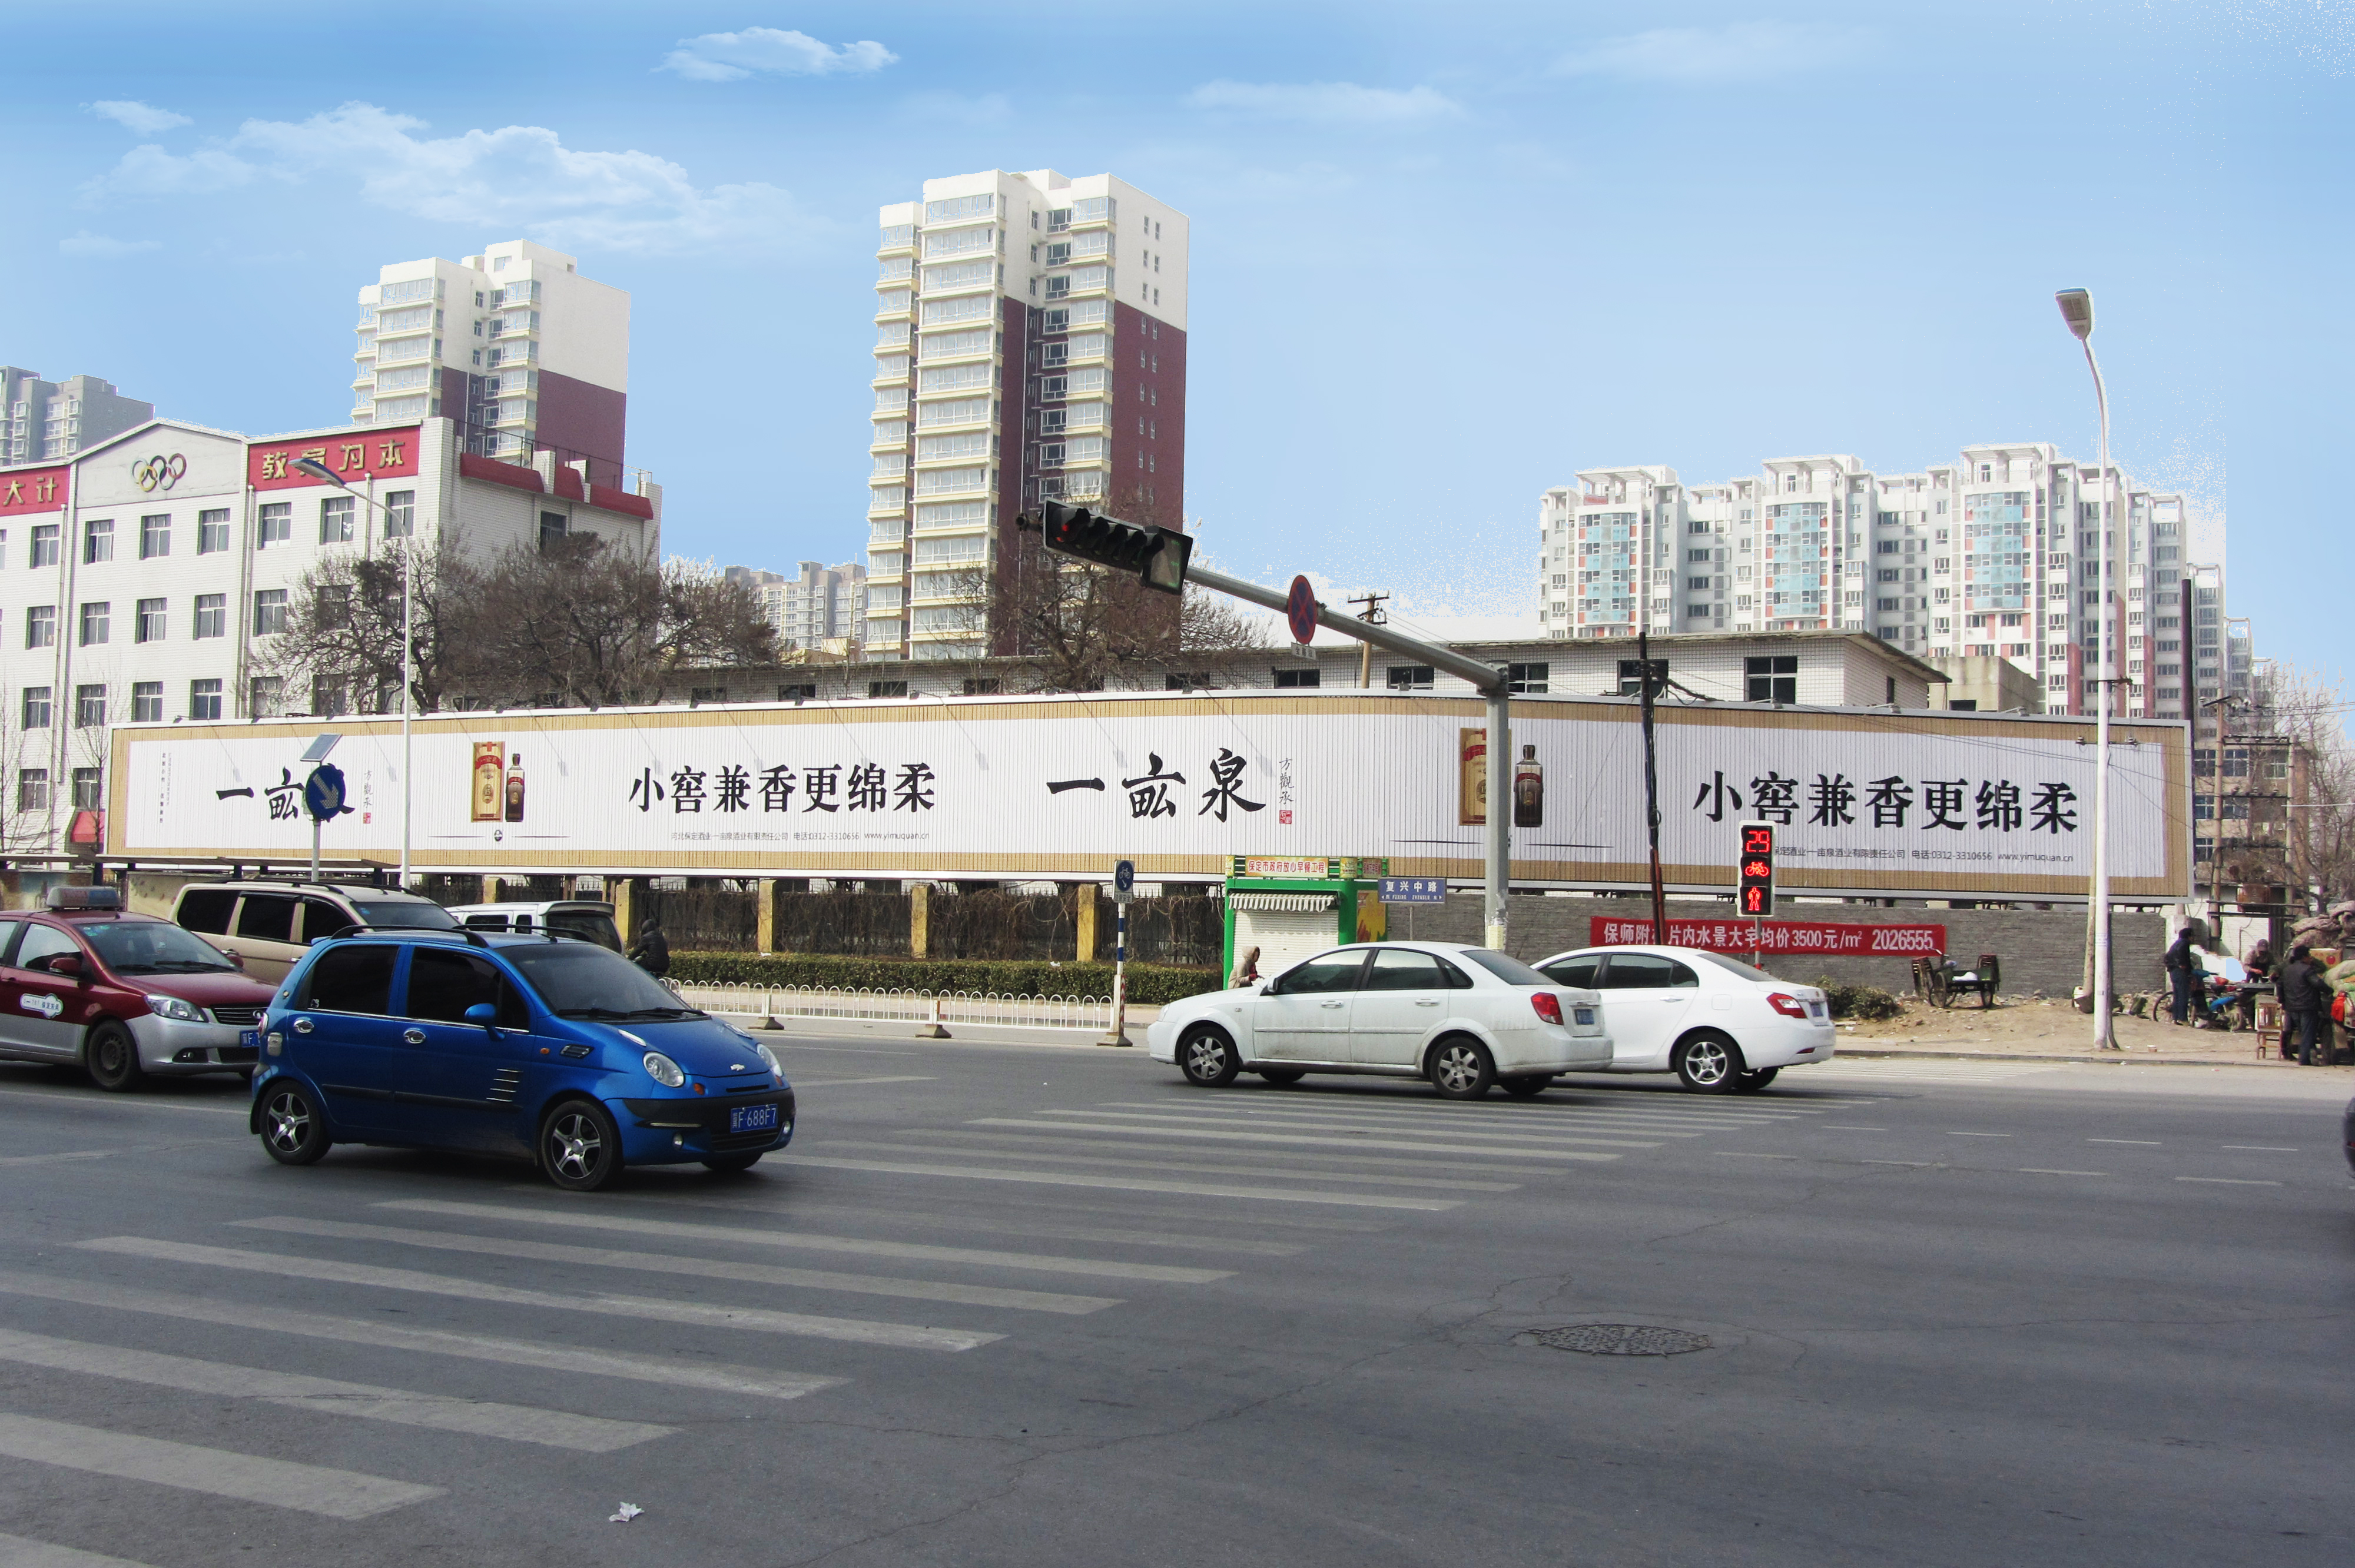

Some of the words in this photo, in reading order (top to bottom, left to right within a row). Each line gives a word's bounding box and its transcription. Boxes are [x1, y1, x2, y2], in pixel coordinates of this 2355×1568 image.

[3, 477, 58, 506] 大计
[629, 762, 935, 813] 小窖兼香更绵柔
[1693, 770, 2078, 835] 小窖兼香更绵柔
[864, 832, 930, 841] www.yimuquan.cn
[1746, 830, 1770, 852] 29
[1248, 860, 1325, 873] 保定市政府放心早餐工程
[1998, 853, 2074, 862] www.yimuquan.cn
[1386, 881, 1437, 893] 复兴中路
[1872, 929, 1933, 951] 2026555
